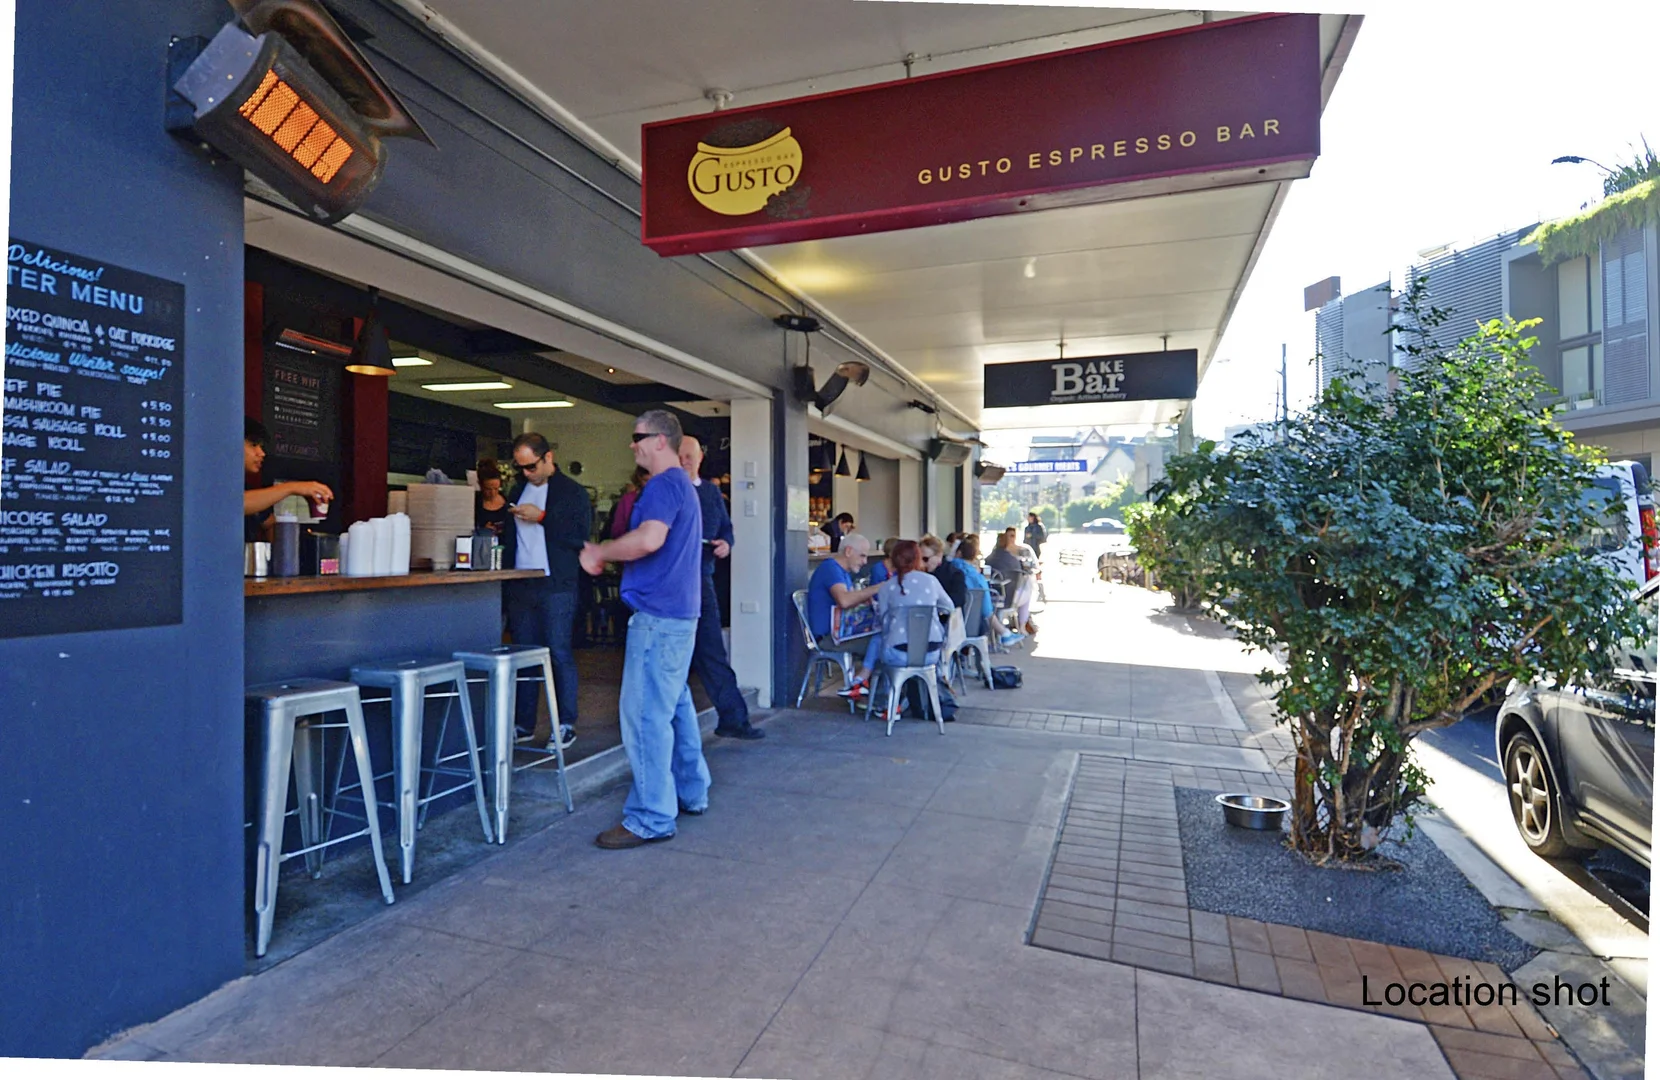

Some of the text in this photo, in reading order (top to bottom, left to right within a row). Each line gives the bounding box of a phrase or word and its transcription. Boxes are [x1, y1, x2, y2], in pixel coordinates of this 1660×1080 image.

[723, 152, 796, 168] ESPRESSO BAR
[917, 118, 1280, 185] GUSTO ESPRESSO BAR
[692, 157, 795, 195] GUSTO
[8, 244, 104, 281] Delicious!
[71, 281, 144, 314] MENU
[42, 313, 90, 335] QUINOA
[108, 326, 129, 342] OAT
[36, 382, 63, 397] PIE
[81, 406, 102, 419] PIE
[32, 417, 88, 435] SAUSAGE
[94, 423, 127, 439] ROLL
[47, 435, 86, 451] ROLL
[24, 458, 71, 475] SALAD
[61, 512, 108, 527] SALAD
[62, 561, 119, 578] RISOTTO
